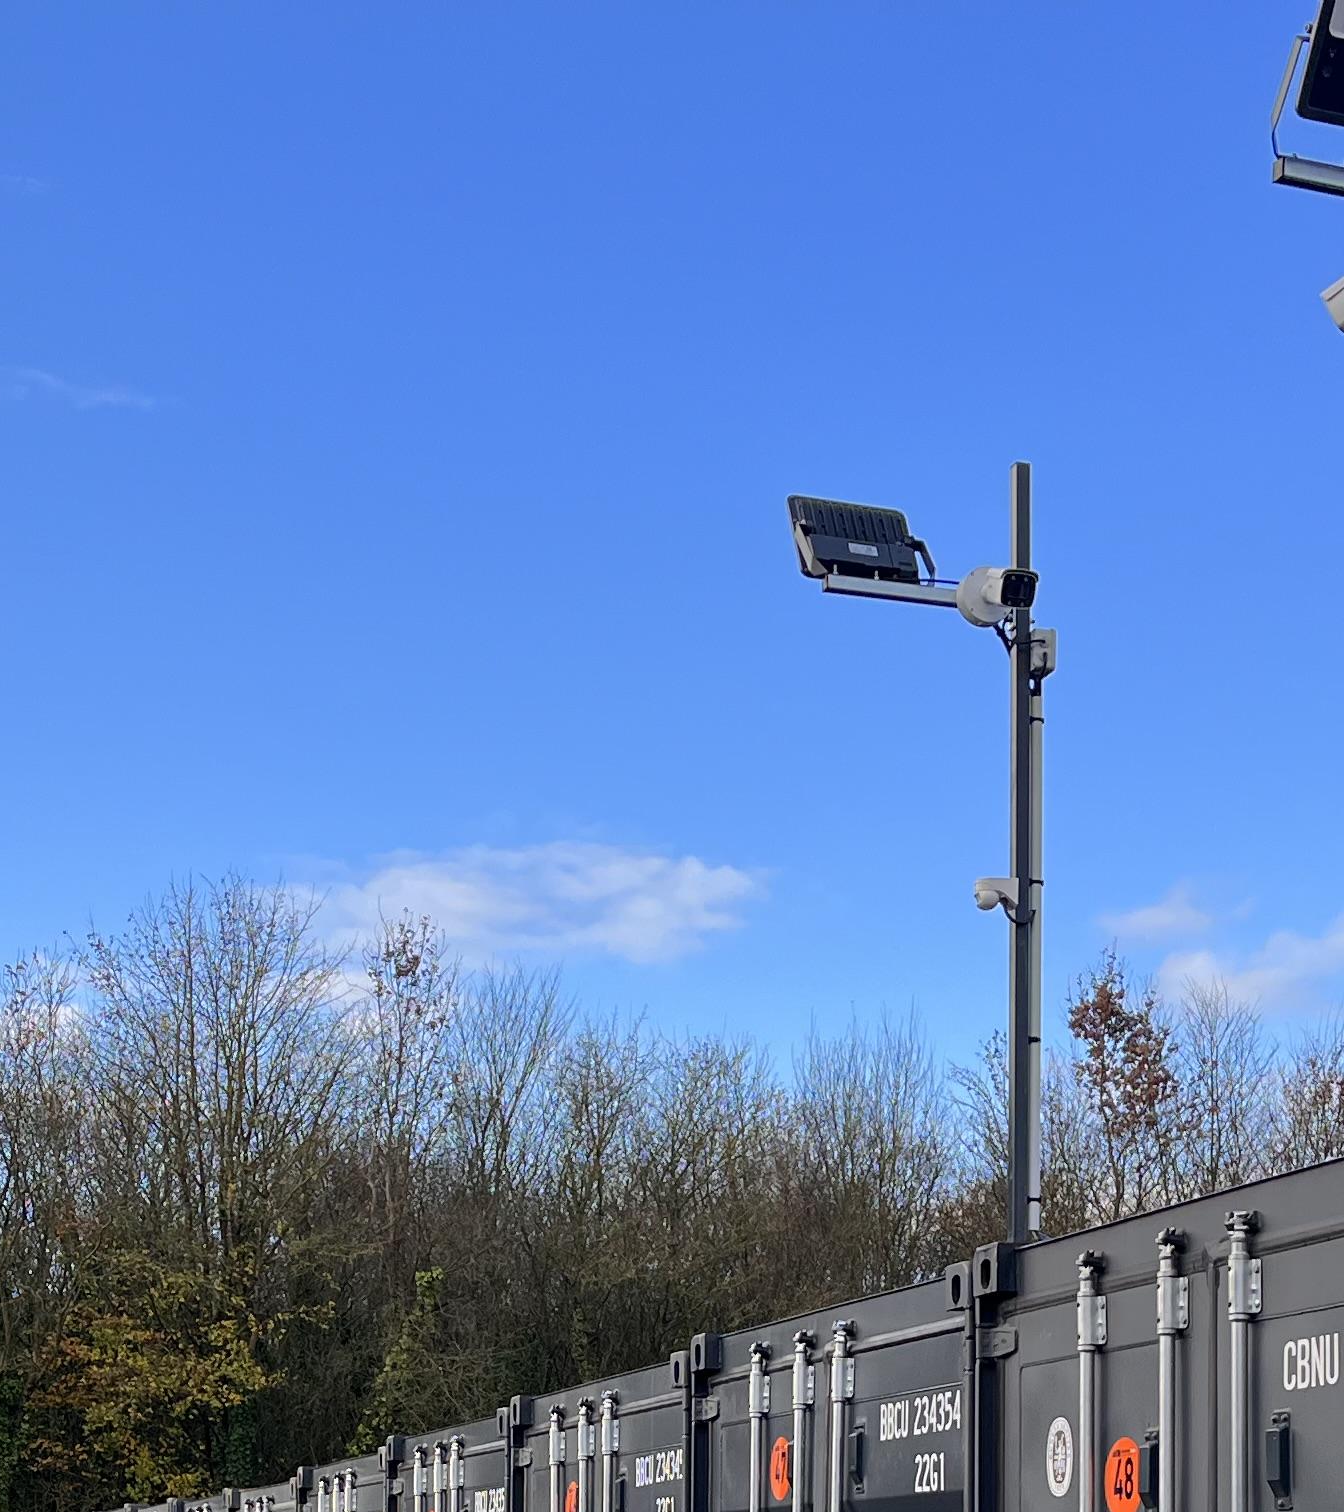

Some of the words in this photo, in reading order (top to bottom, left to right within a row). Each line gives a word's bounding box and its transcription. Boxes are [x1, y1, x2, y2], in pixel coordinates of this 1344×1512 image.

[1283, 1332, 1339, 1391] CBNU
[880, 1400, 909, 1441] BBCU
[913, 1389, 961, 1435] 234354
[914, 1451, 945, 1492] 22G1
[1113, 1457, 1134, 1501] 48
